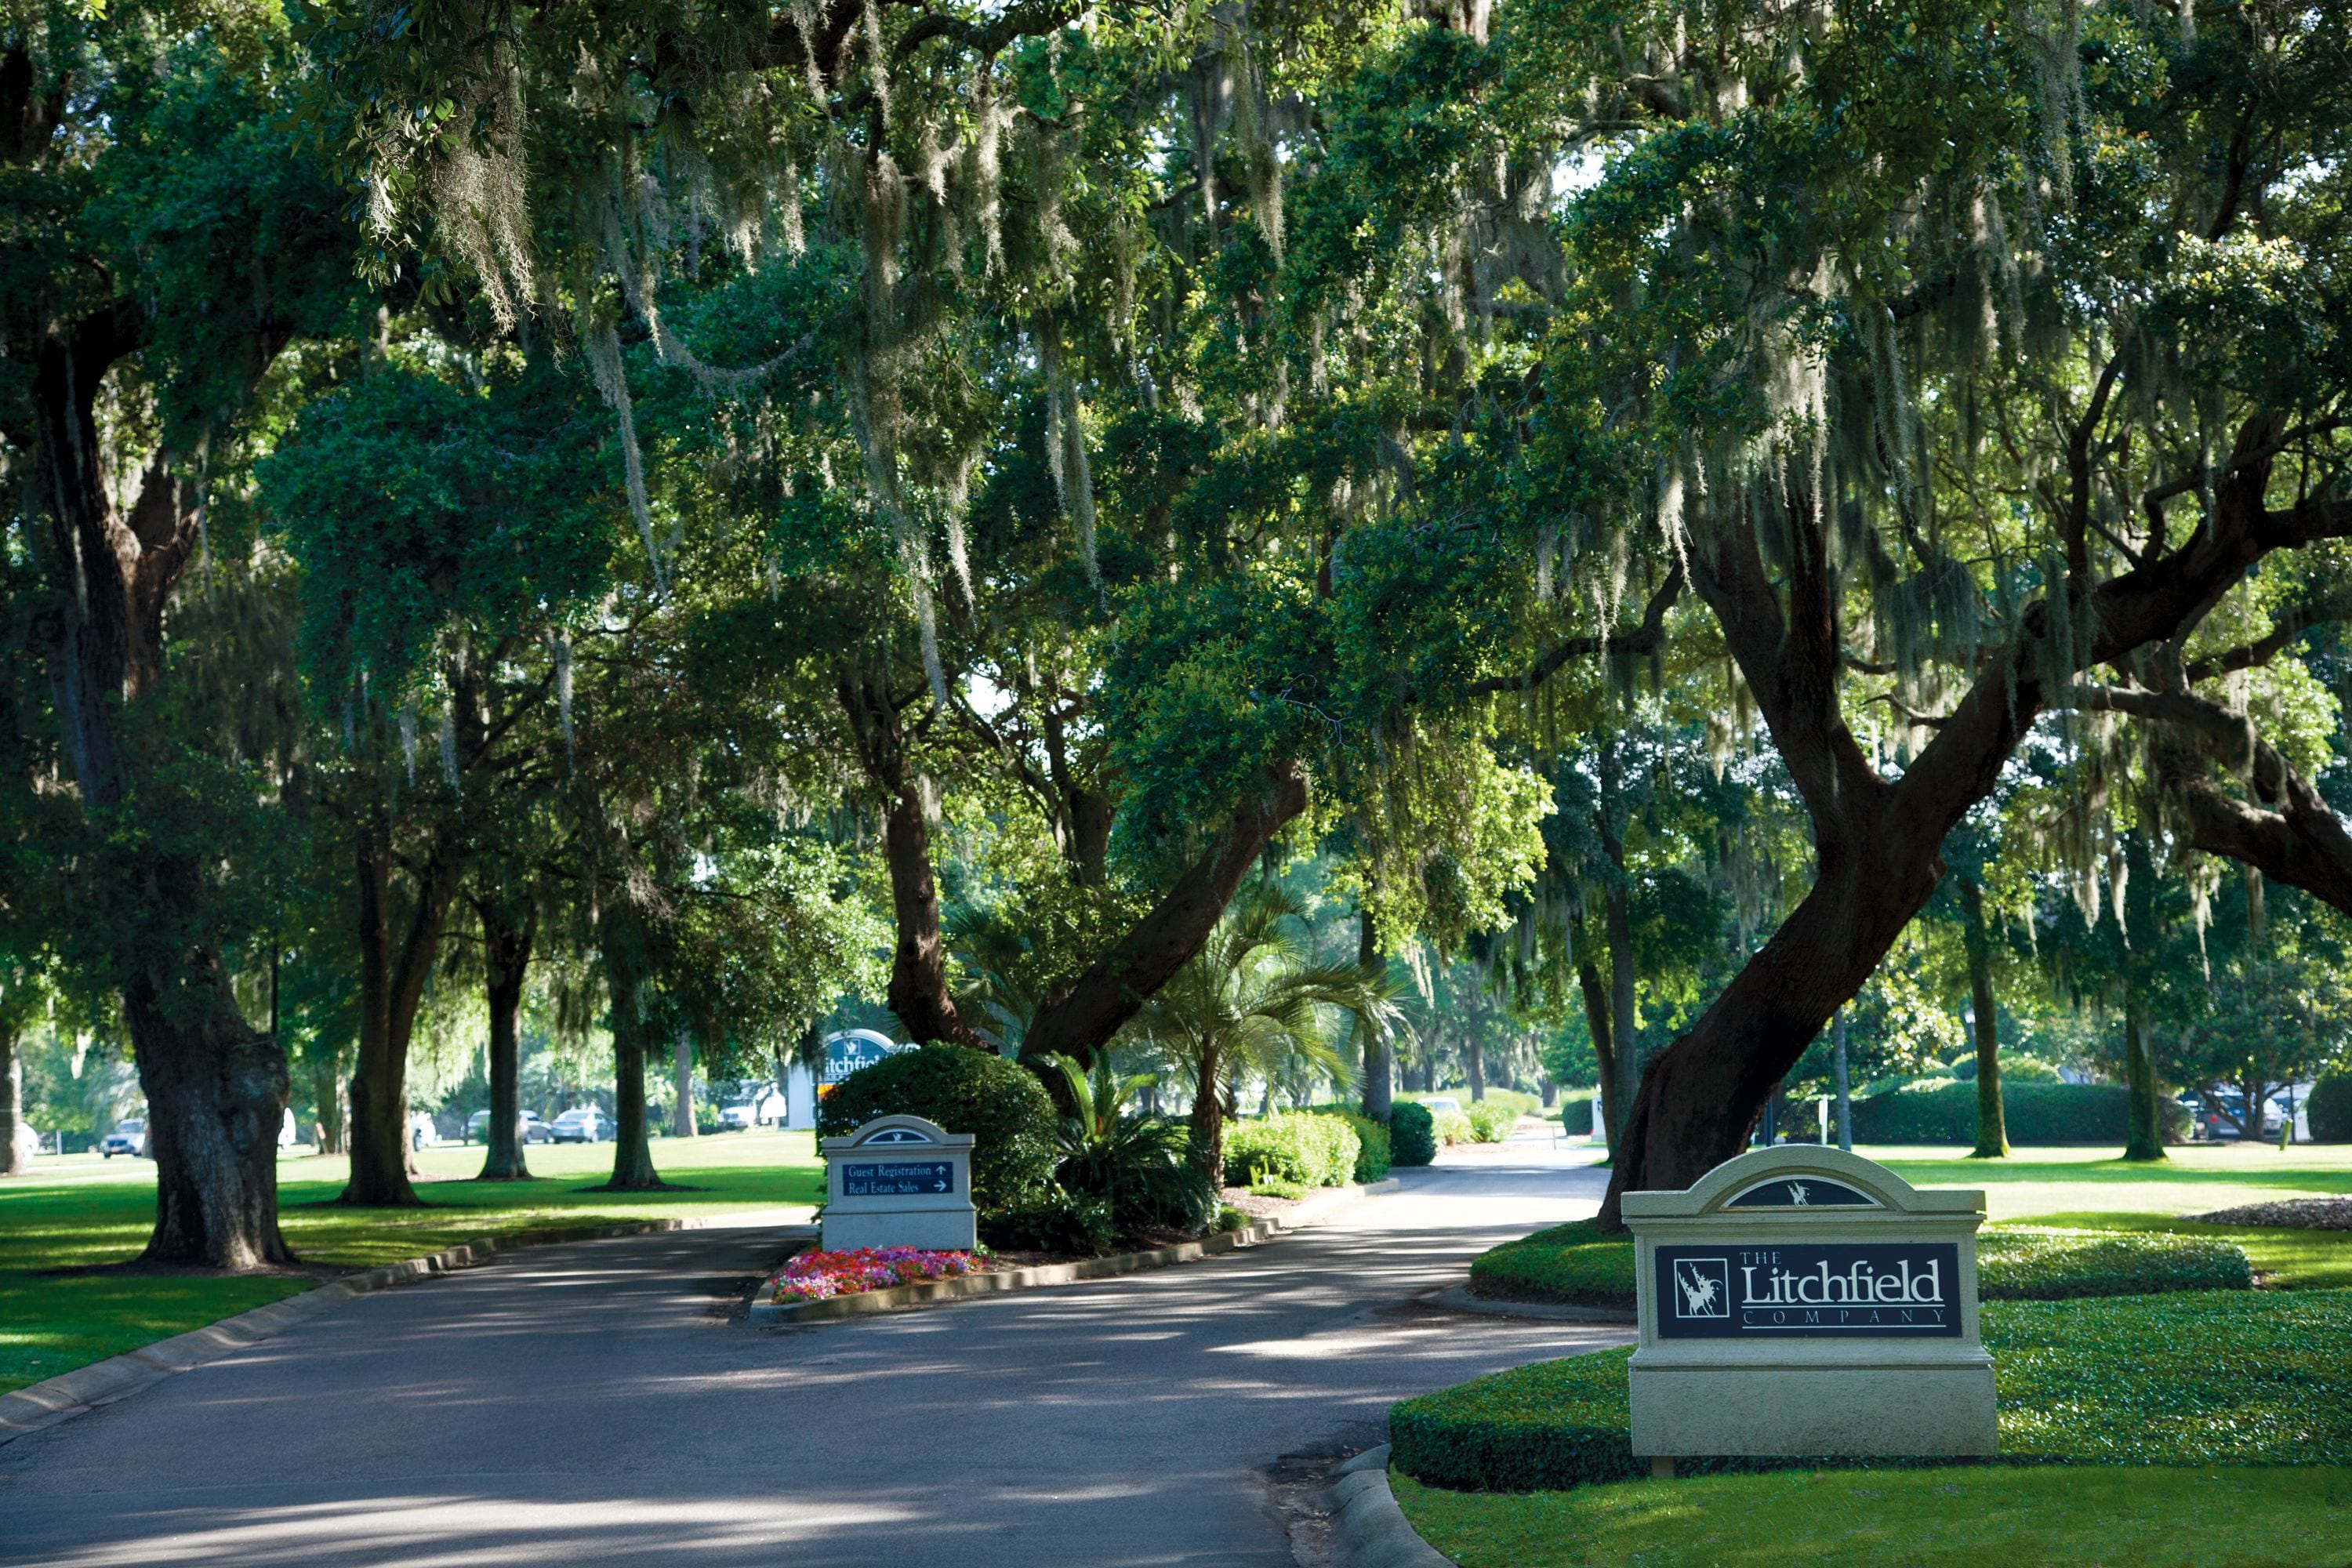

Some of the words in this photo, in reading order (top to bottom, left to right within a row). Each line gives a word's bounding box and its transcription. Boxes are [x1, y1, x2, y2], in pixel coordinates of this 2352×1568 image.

[848, 1166, 874, 1178] Guest
[878, 1164, 931, 1179] Registration
[849, 1181, 867, 1194] Real
[871, 1181, 895, 1194] Estate
[898, 1181, 919, 1192] Sales
[1739, 1251, 1782, 1265] THE
[1740, 1258, 1944, 1303] Litchfield
[1743, 1308, 1944, 1324] COMPANY
